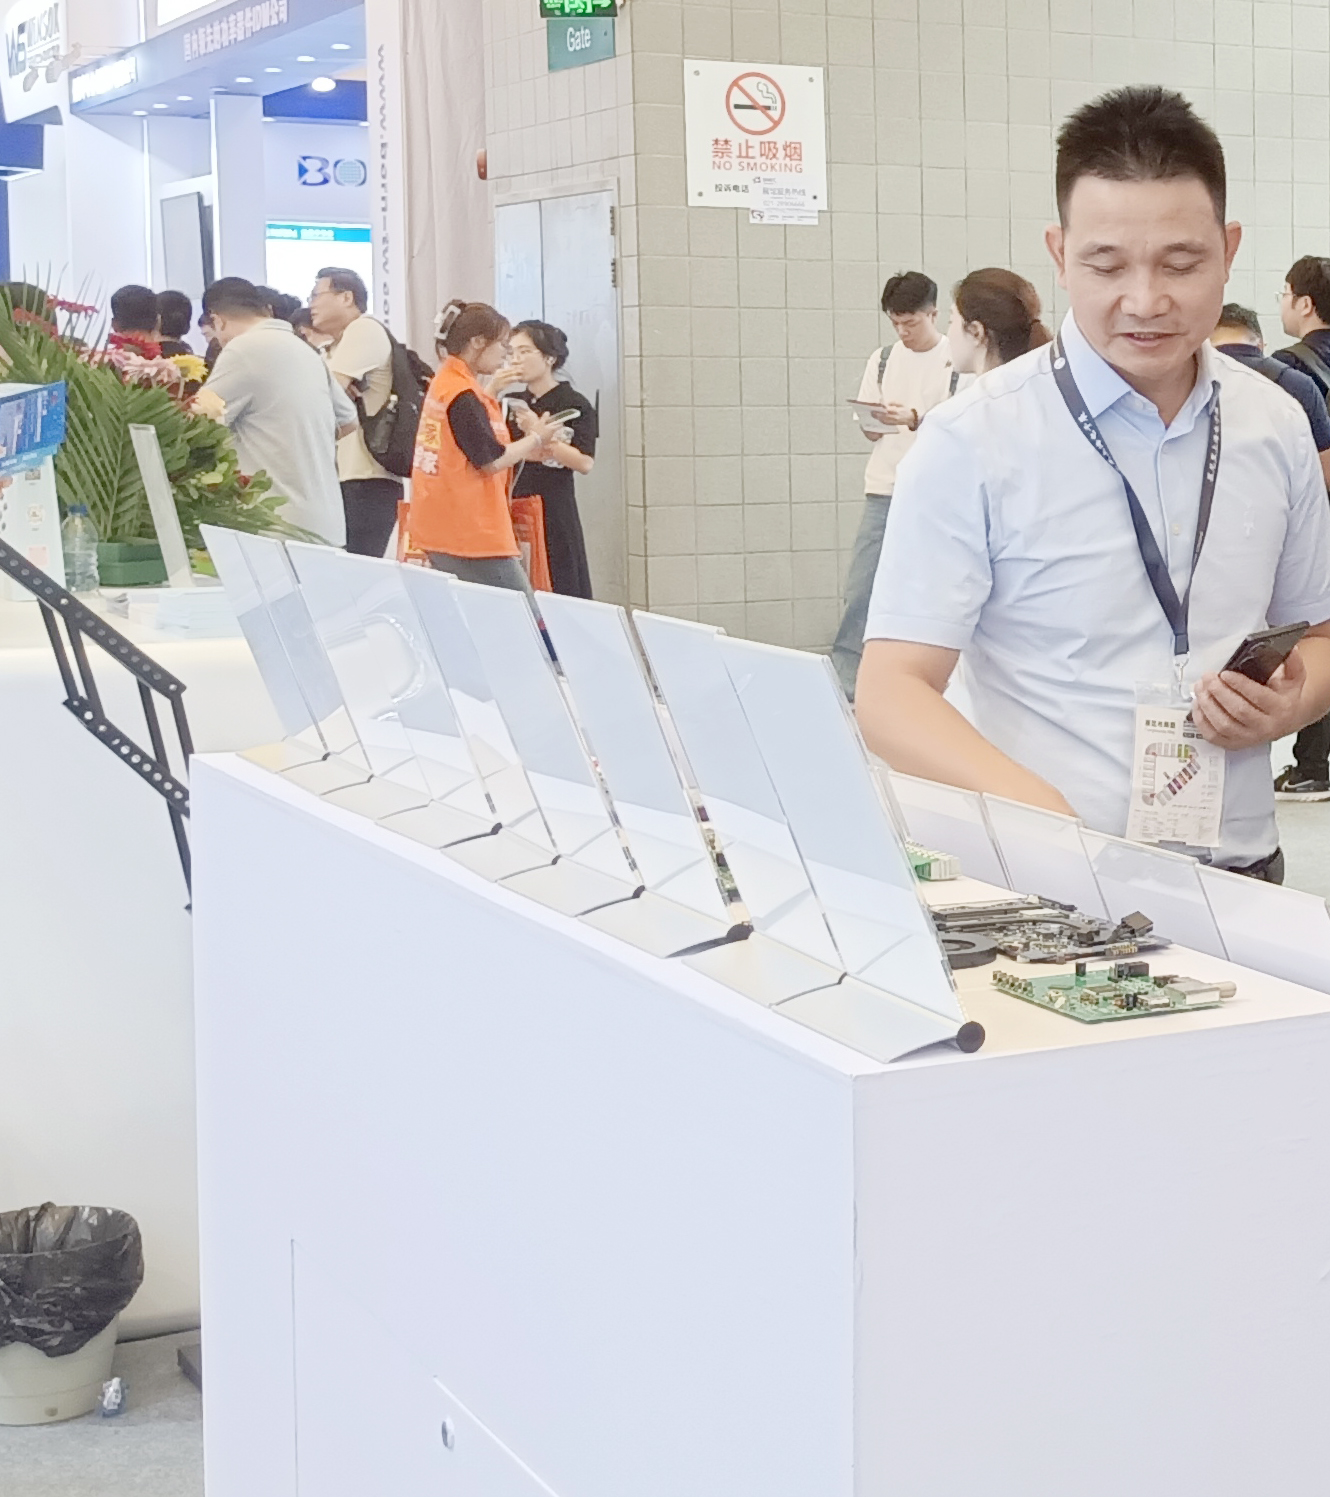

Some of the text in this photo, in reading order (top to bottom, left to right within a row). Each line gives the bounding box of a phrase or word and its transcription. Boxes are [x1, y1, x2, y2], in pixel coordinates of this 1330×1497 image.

[567, 26, 591, 52] Gate
[712, 138, 803, 161] 禁止吸烟
[712, 161, 803, 173] NO SMOKING
[714, 183, 749, 193] 投诉电话
